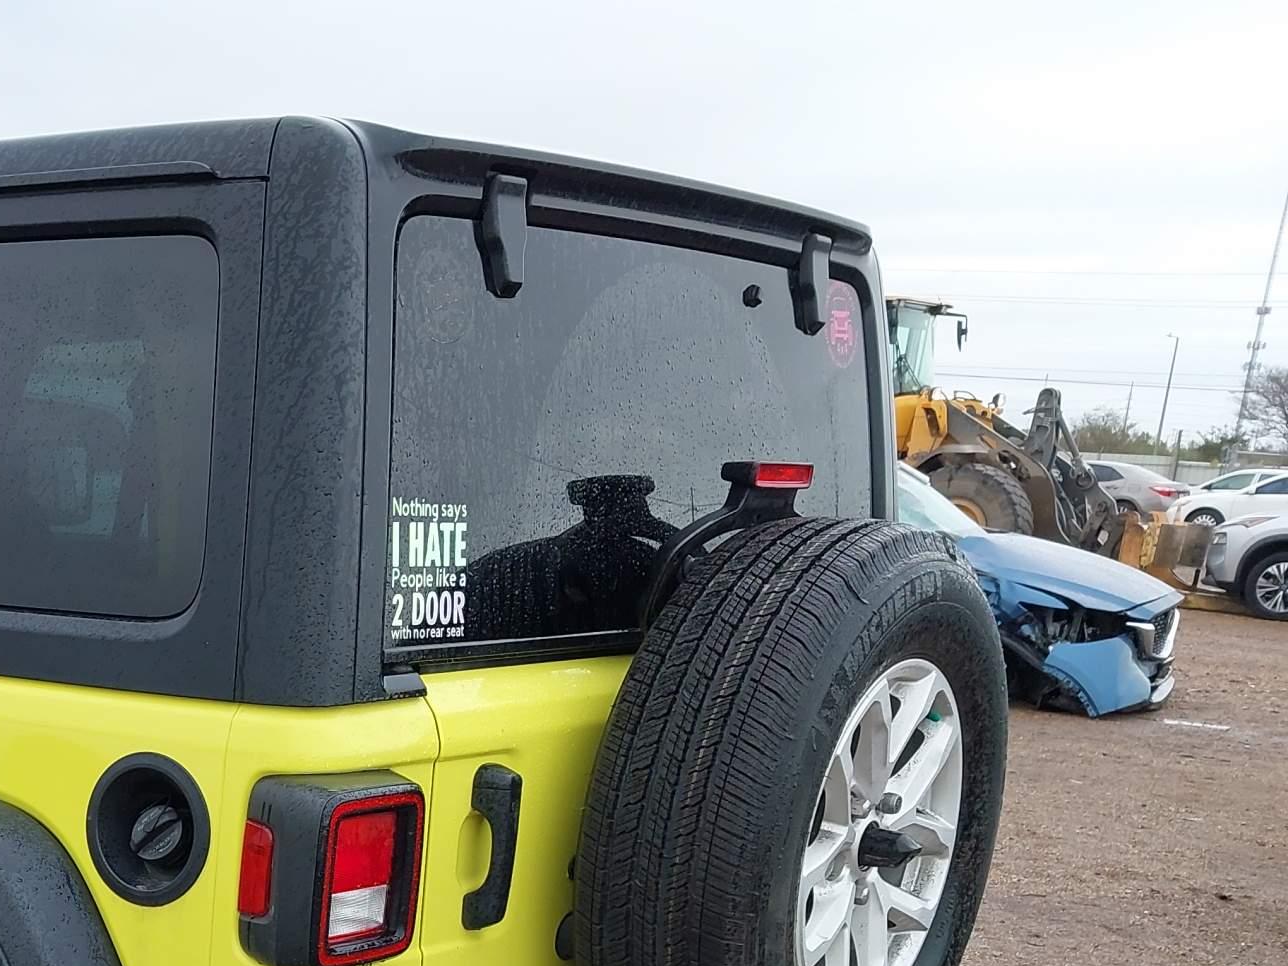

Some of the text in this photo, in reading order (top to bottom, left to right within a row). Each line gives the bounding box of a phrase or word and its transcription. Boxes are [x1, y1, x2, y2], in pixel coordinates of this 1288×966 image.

[392, 496, 468, 522] Nothing says
[391, 521, 468, 568] I HATE
[391, 568, 466, 592] People like a
[391, 591, 465, 627] 2 DOOR
[391, 625, 465, 640] with no rear seat
